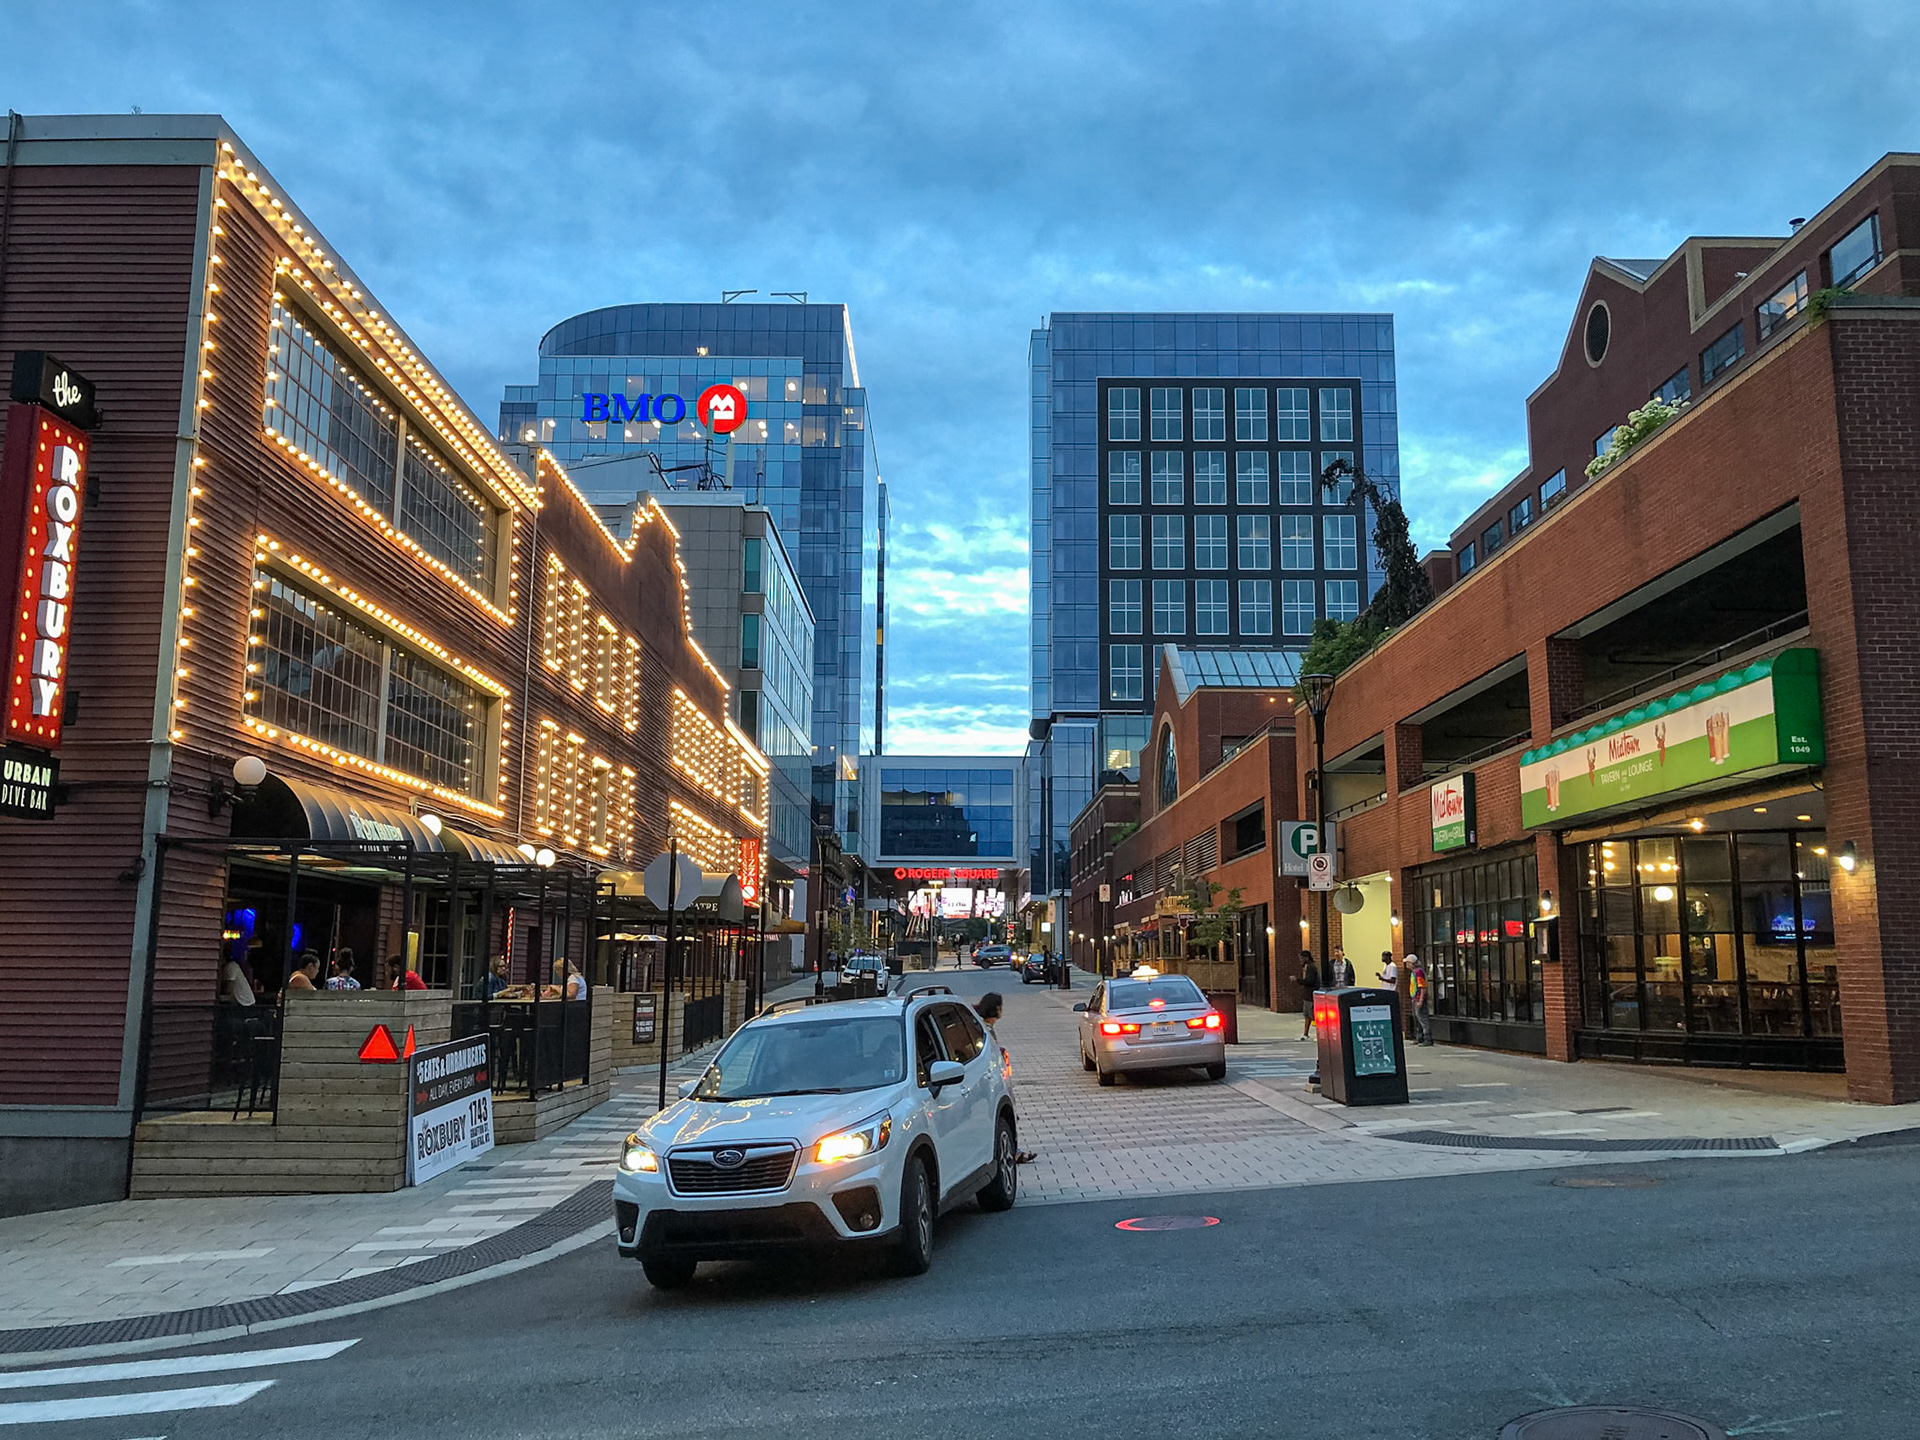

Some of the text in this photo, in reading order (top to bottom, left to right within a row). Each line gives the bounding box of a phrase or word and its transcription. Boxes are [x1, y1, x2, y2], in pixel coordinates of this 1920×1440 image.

[53, 371, 81, 407] the
[580, 393, 686, 424] BMO
[33, 445, 79, 717] ROXBURY
[1791, 735, 1808, 743] Est.
[4, 760, 51, 787] URBAN
[1600, 770, 1620, 784] TAVERN
[1628, 759, 1653, 777] LOUNGE
[1, 783, 47, 811] DIVE BAR
[1300, 829, 1319, 854] P
[748, 841, 757, 886] PIZZA
[908, 868, 999, 879] ROGERS SQUARE
[1284, 862, 1304, 872] Hotel
[1703, 937, 1711, 949] 9
[424, 1056, 440, 1083] EATS
[440, 1058, 445, 1077] &
[467, 1043, 487, 1068] BEATS
[469, 1096, 488, 1126] 1743
[417, 1114, 466, 1160] ROXBURY
